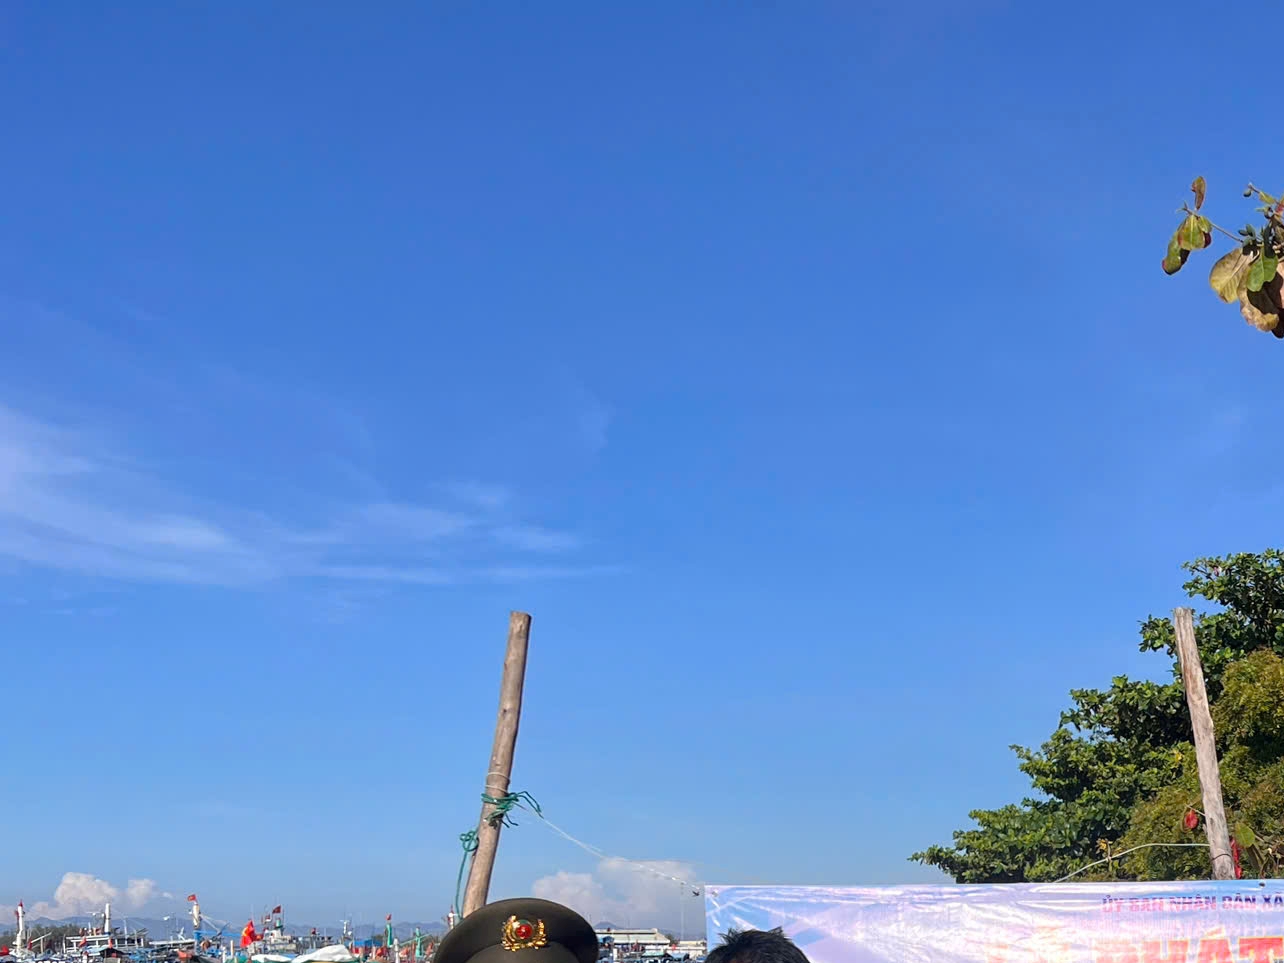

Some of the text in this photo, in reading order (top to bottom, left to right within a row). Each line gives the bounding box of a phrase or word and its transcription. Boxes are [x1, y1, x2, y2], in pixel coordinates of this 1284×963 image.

[1169, 892, 1216, 911] NHÂN
[1222, 892, 1257, 910] DÂN
[1262, 890, 1283, 908] XÃ
